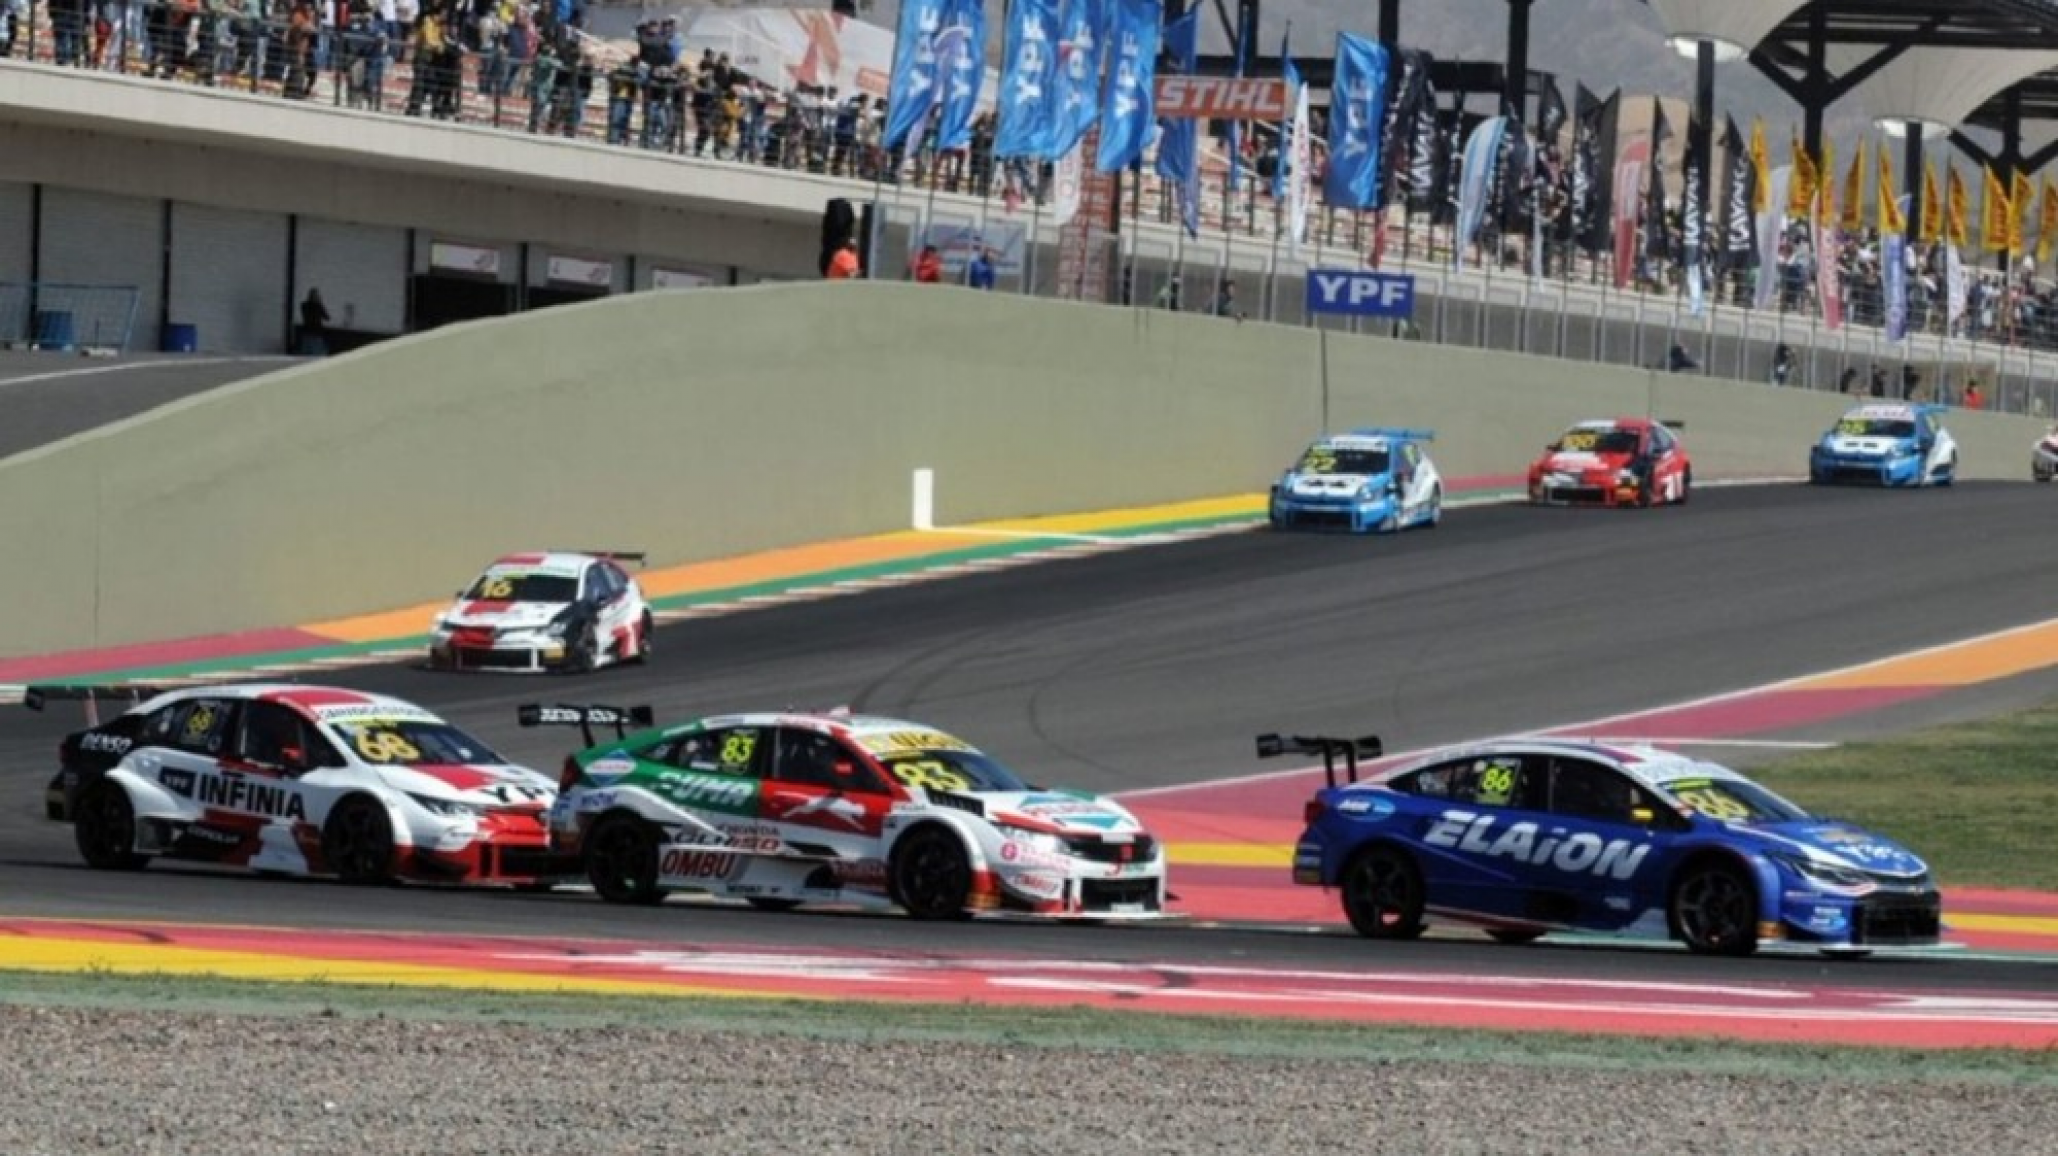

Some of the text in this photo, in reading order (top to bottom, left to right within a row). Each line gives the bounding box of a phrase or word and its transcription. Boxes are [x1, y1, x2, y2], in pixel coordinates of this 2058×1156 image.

[1016, 13, 1046, 105] YPF
[1114, 30, 1139, 119] YPF
[1156, 79, 1283, 111] STIHL
[1344, 76, 1371, 160] YPF
[1315, 274, 1409, 306] YPF
[483, 579, 514, 598] 16
[723, 736, 755, 763] 83
[893, 760, 970, 792] 83
[1483, 767, 1512, 792] 86
[200, 771, 306, 821] INFINIA
[661, 850, 736, 879] OMBU
